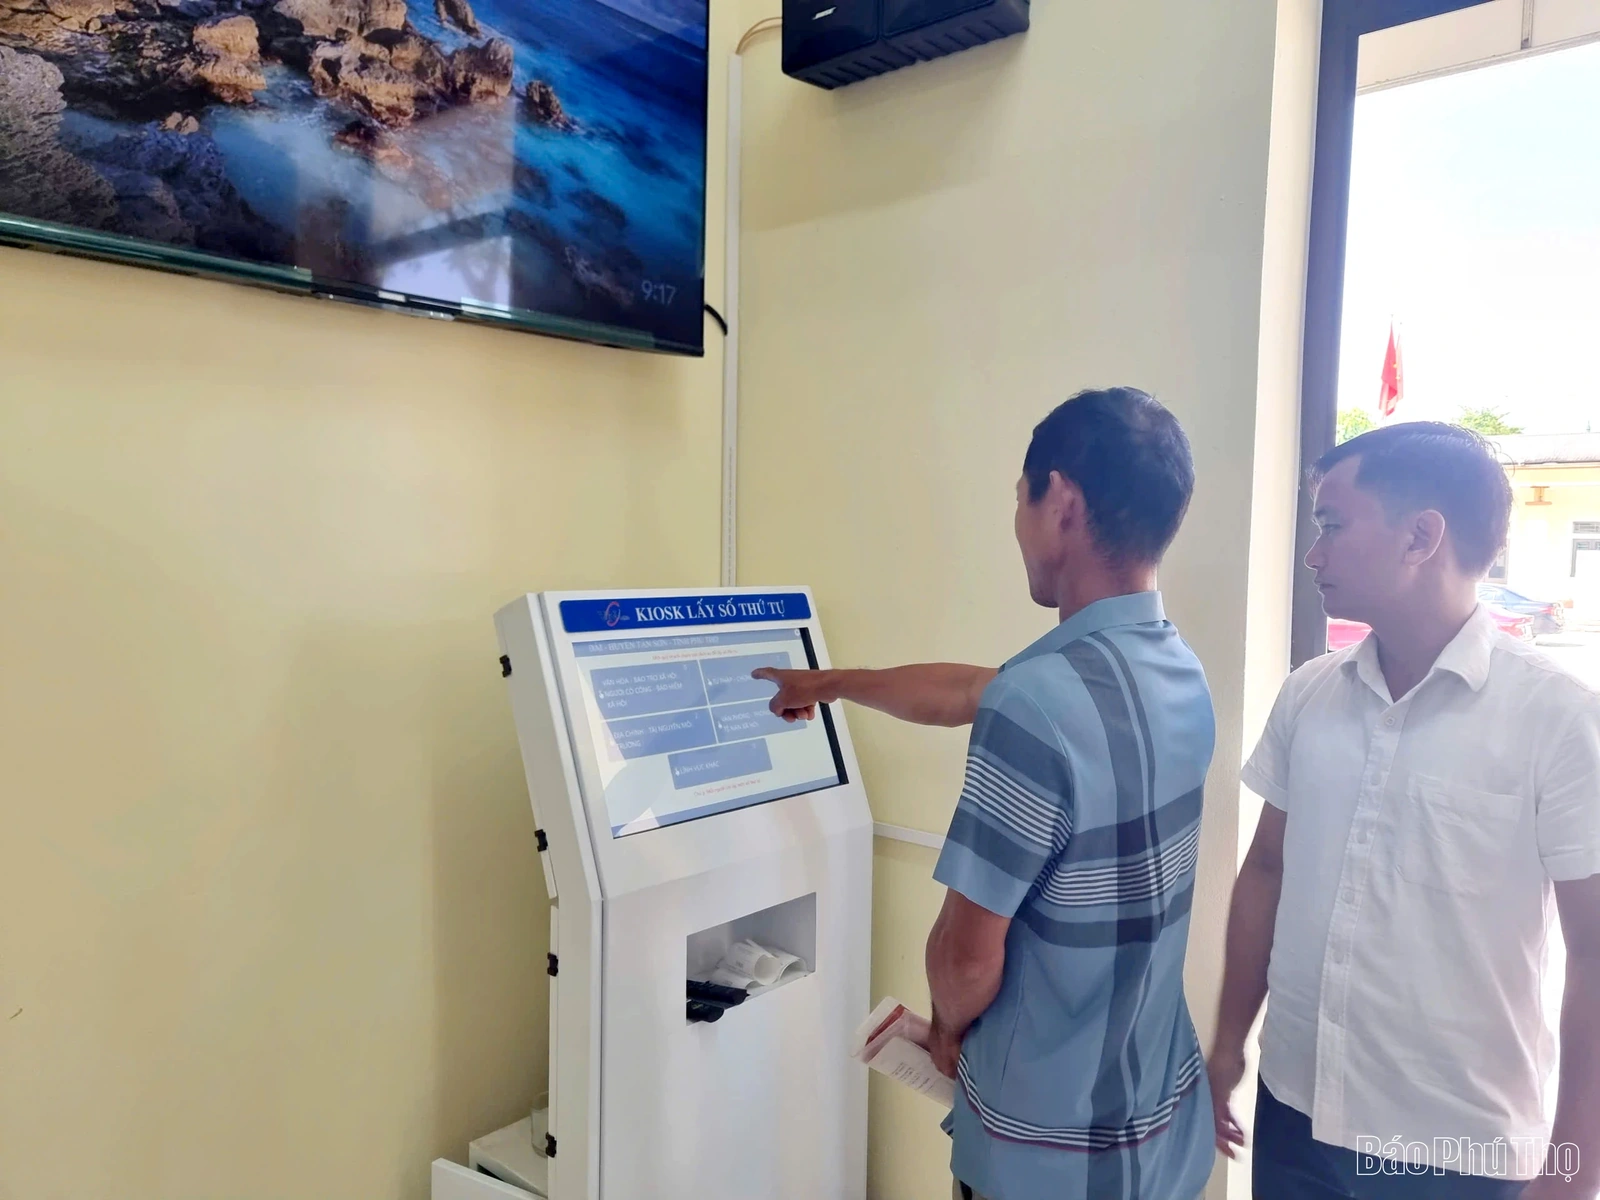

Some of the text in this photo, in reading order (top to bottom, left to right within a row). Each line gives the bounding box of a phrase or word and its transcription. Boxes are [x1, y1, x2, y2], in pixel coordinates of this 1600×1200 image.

[641, 280, 677, 305] 9:17
[635, 606, 685, 621] KIOSK
[686, 598, 714, 619] LẤY
[718, 597, 737, 617] SỐ
[738, 598, 766, 616] THỨ
